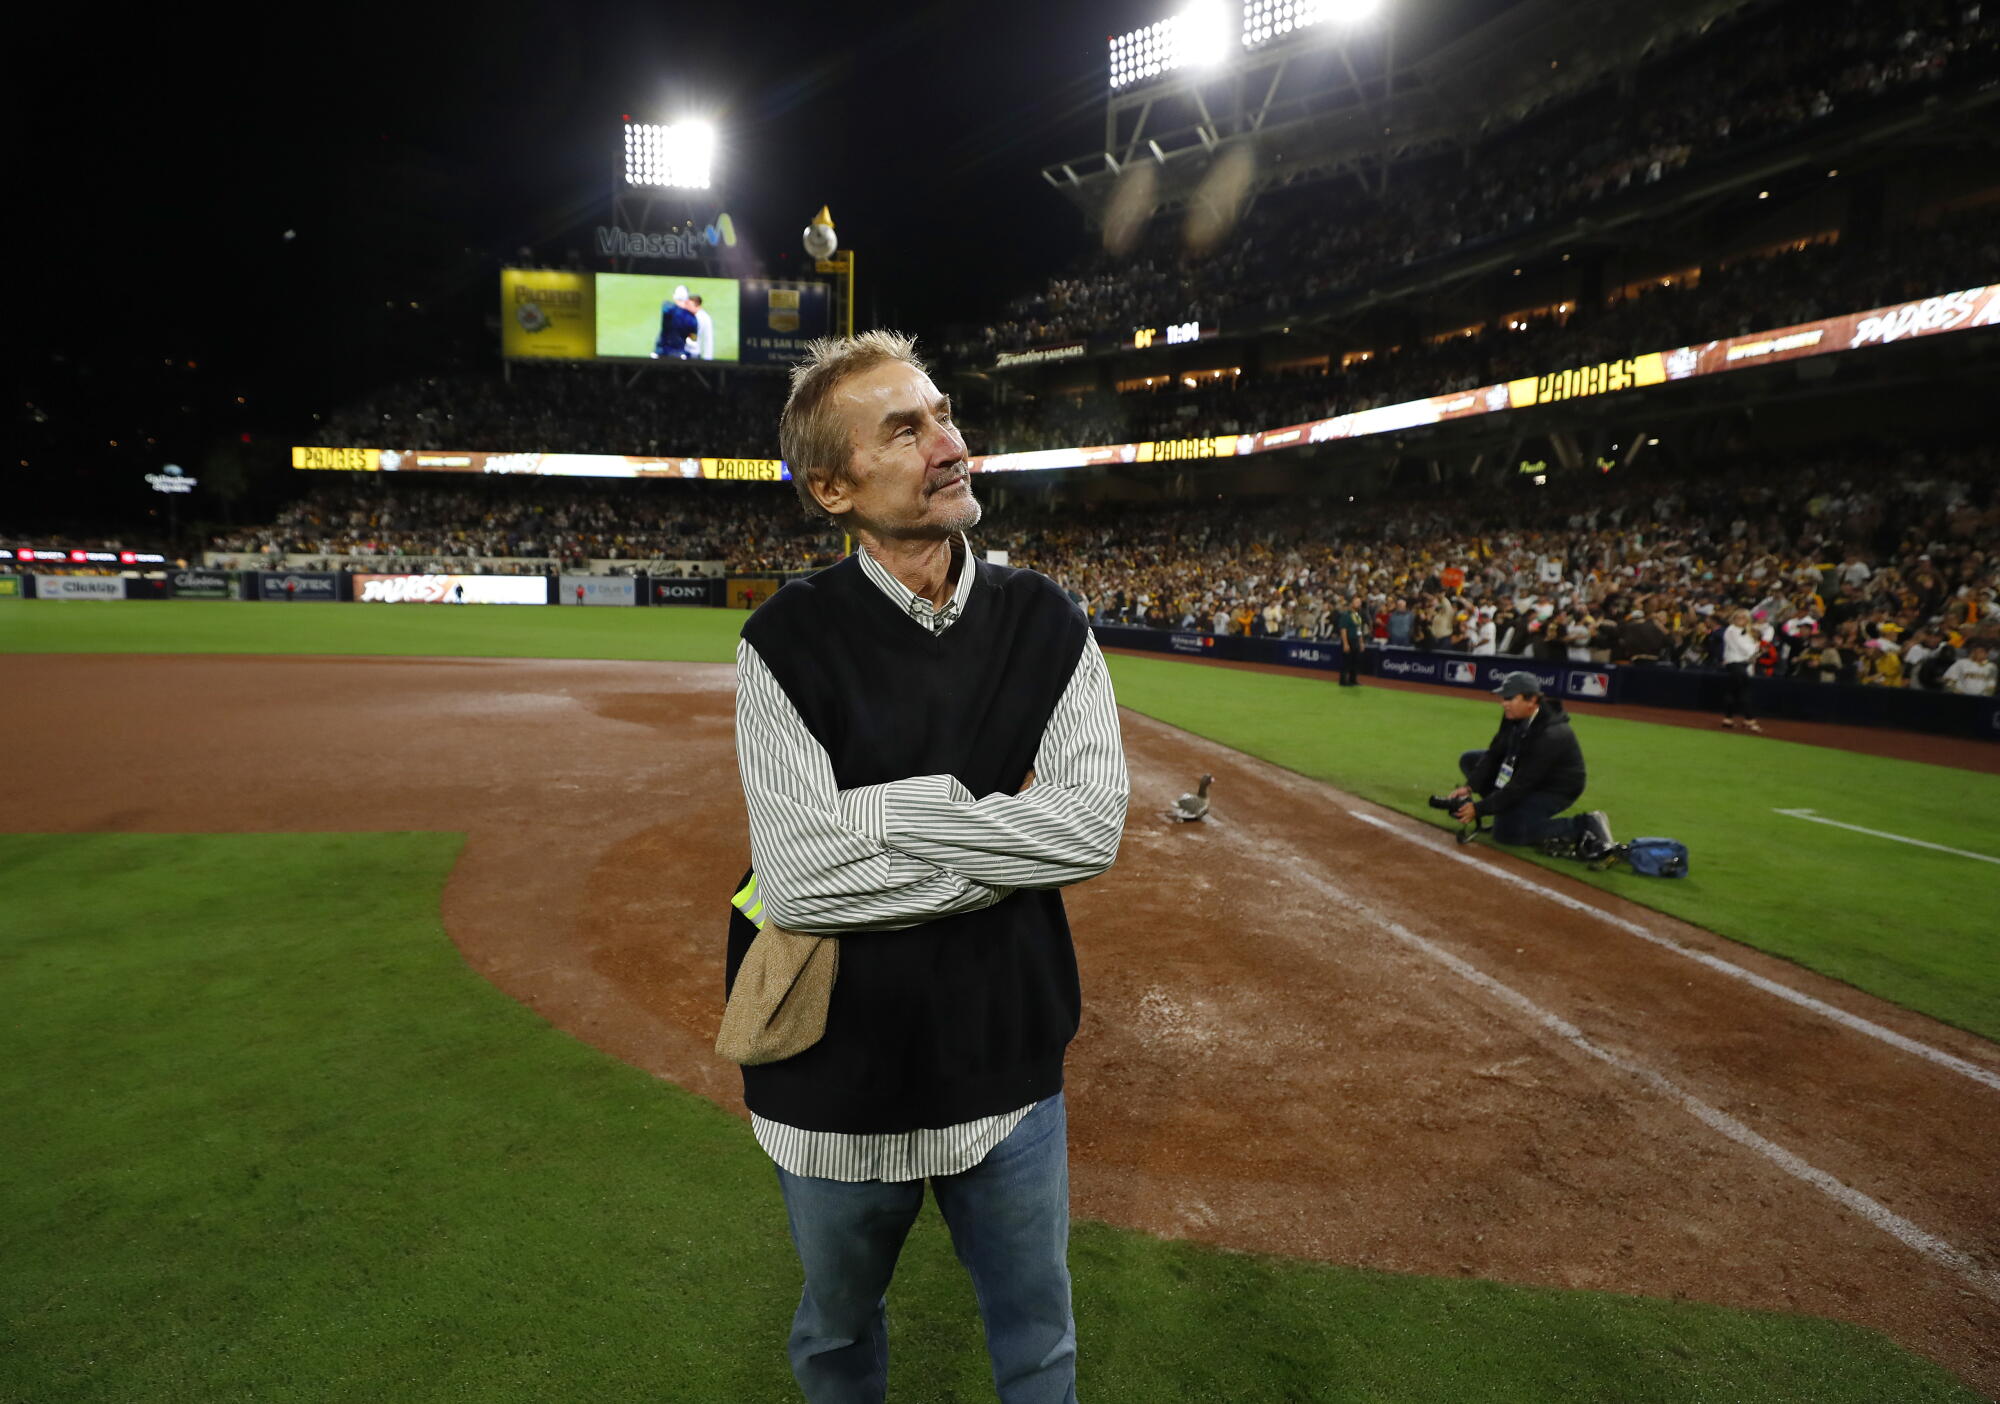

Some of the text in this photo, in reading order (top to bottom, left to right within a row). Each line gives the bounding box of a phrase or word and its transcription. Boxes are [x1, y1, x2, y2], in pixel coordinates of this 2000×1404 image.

[597, 226, 697, 258] Viasat
[1851, 286, 1985, 348] PADRES
[1538, 358, 1636, 404] PADRES
[304, 448, 366, 470] PADRES
[1155, 438, 1216, 461] PADRES
[717, 459, 774, 480] PADRES
[661, 586, 706, 597] SONY
[1299, 649, 1320, 661] MLB
[1383, 660, 1435, 674] Google Cloud
